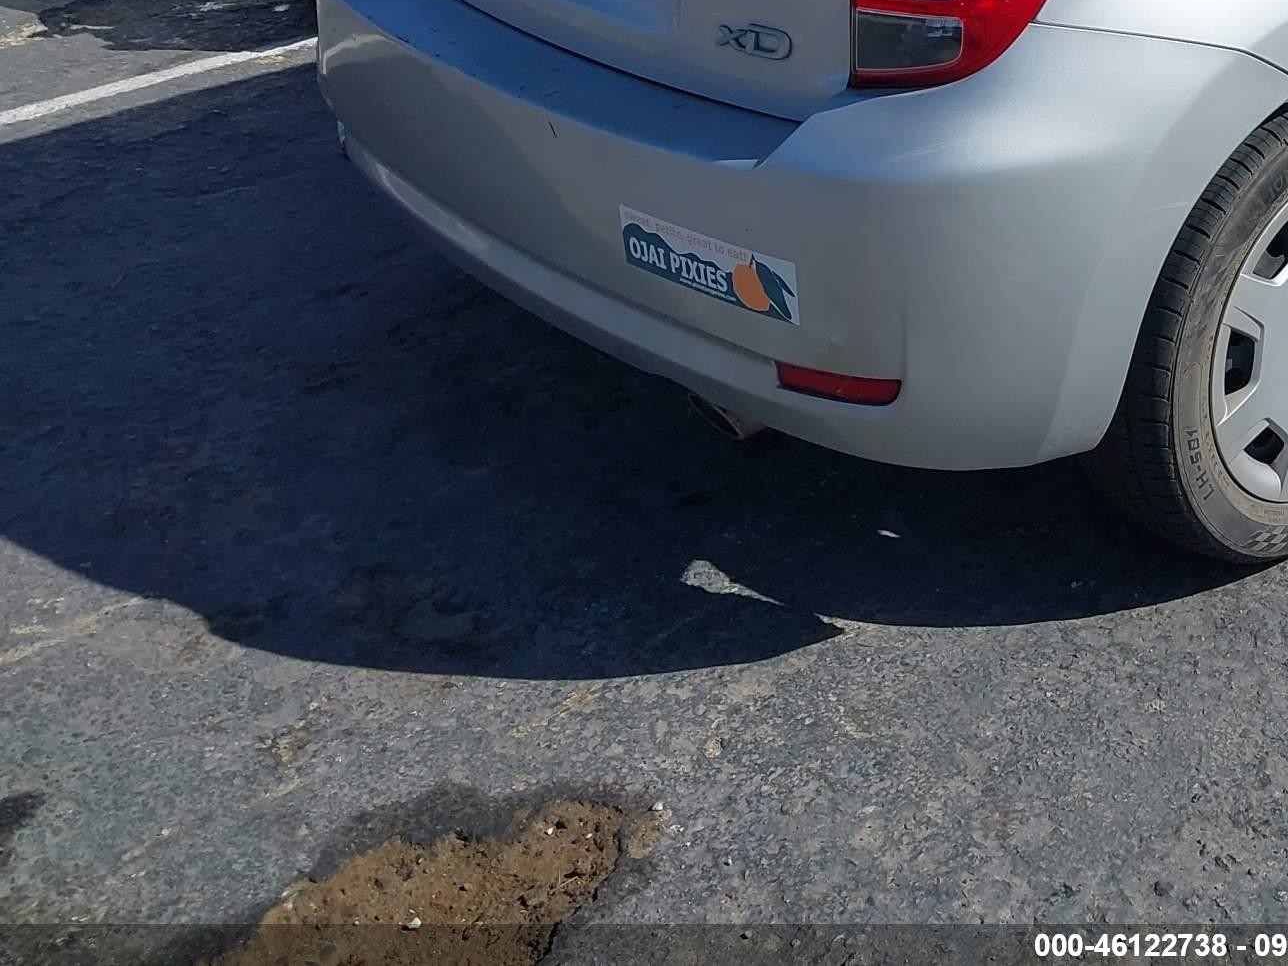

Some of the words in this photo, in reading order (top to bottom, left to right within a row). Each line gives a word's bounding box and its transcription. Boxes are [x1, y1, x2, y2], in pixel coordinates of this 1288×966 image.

[629, 236, 668, 270] OJAI
[669, 251, 728, 292] PIXIES
[1184, 427, 1215, 501] LH-501
